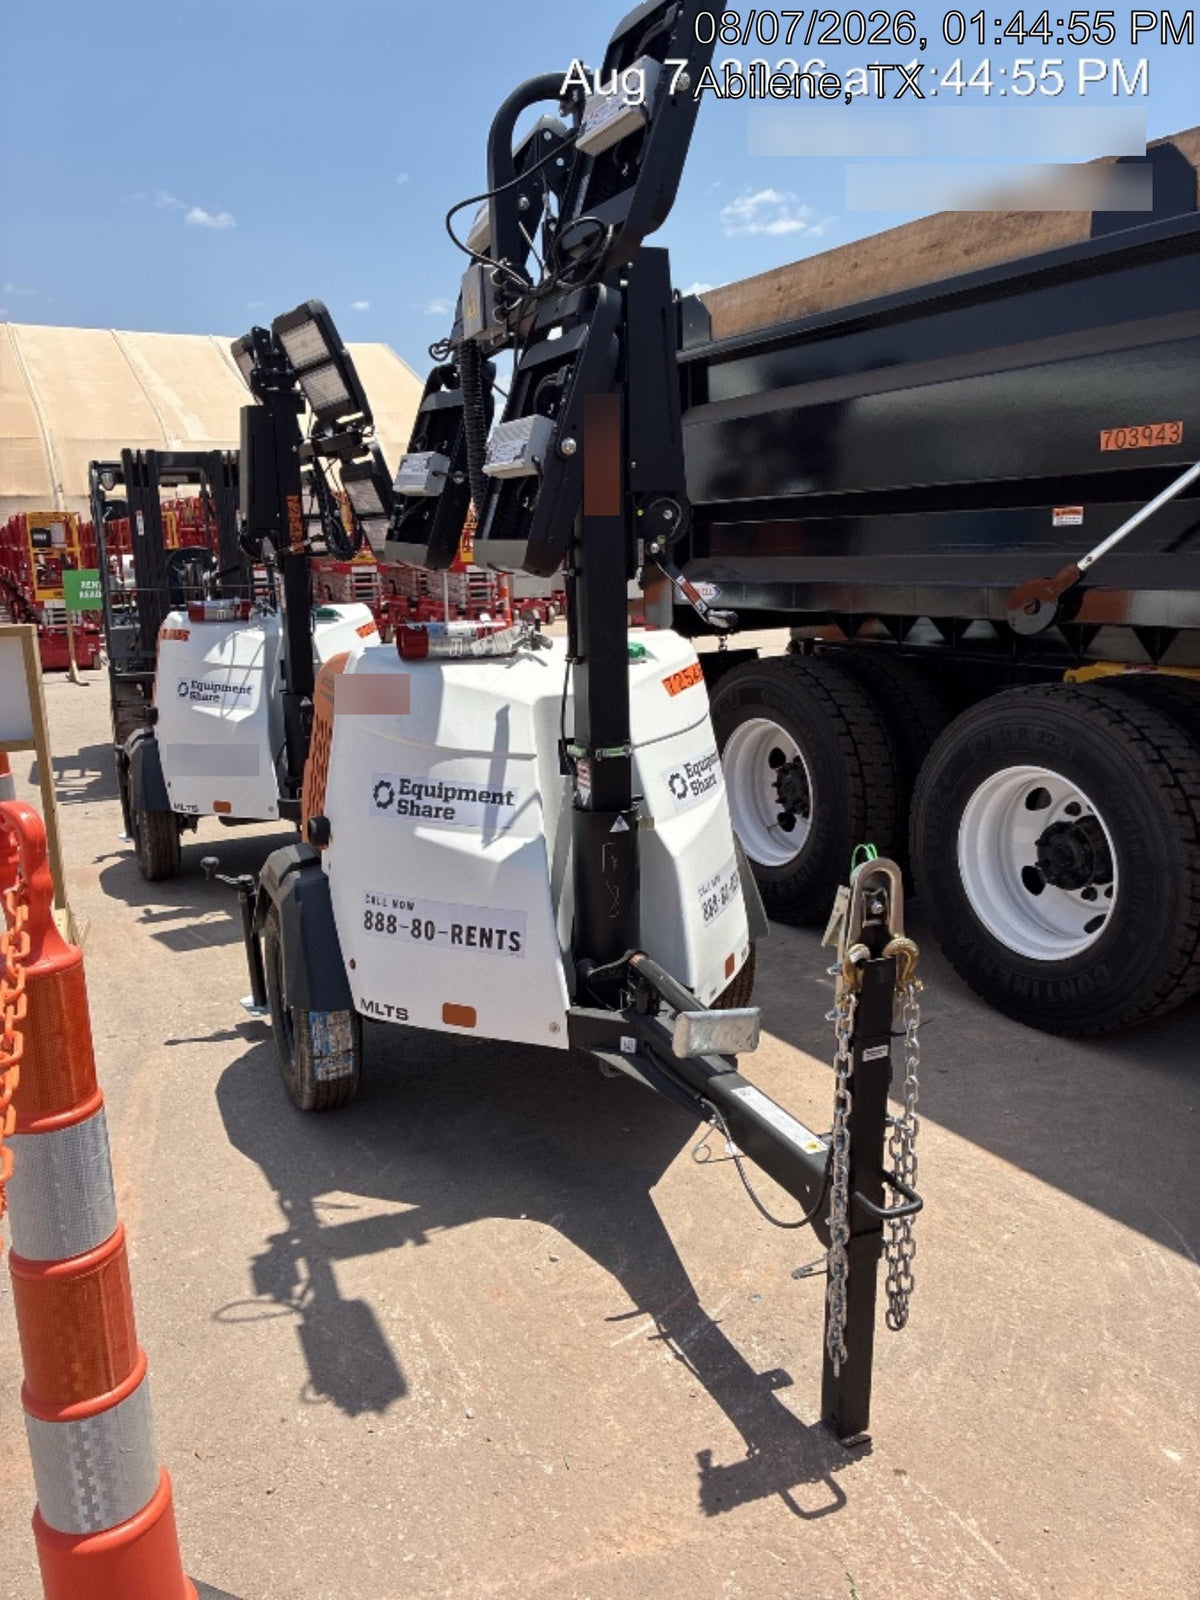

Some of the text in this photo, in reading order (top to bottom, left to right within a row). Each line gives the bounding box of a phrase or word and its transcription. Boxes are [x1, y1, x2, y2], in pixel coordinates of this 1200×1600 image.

[1103, 423, 1181, 449] 703943
[189, 691, 221, 702] Share
[190, 680, 252, 695] Equipment
[399, 778, 515, 806] Equipment
[397, 799, 456, 820] Share
[365, 893, 416, 911] CALL NOW
[363, 909, 522, 952] 888-80-RENTS
[360, 998, 410, 1021] MLTS
